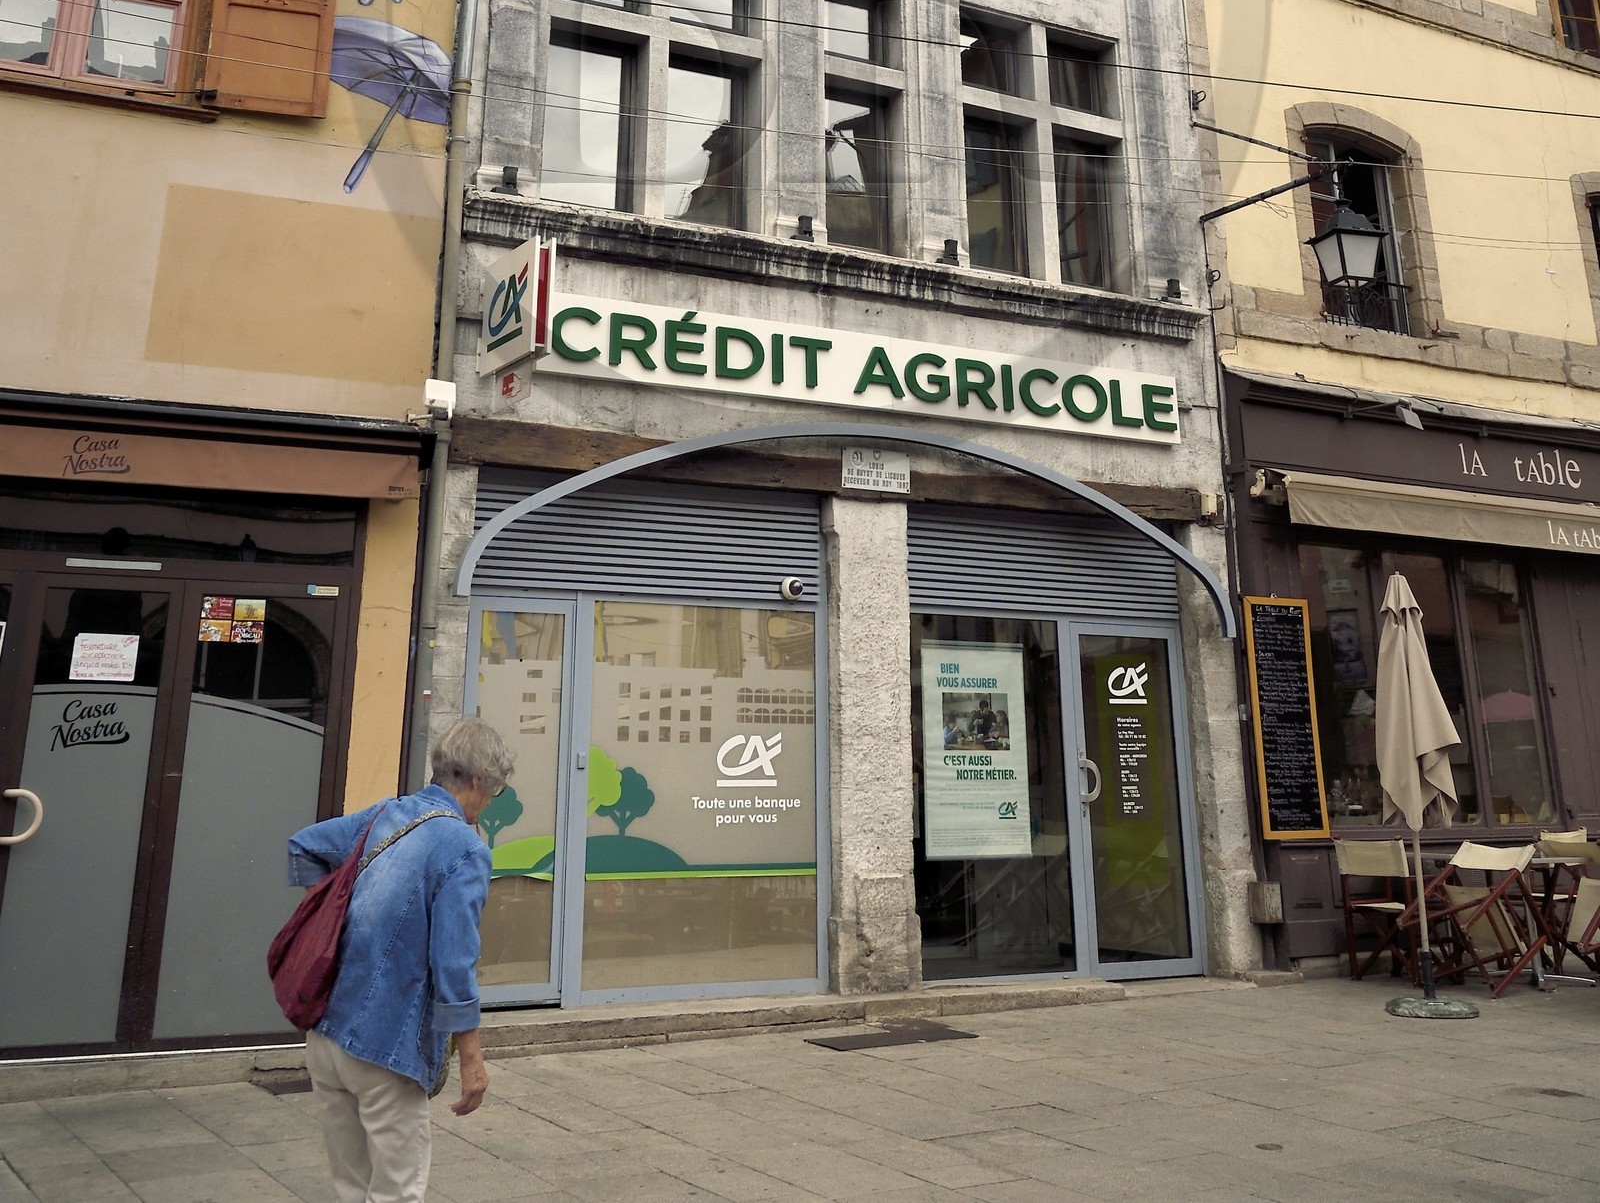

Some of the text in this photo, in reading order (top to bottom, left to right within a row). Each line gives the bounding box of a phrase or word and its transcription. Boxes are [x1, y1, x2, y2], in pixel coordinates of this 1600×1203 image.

[551, 306, 1178, 432] CRÉDIT AGRICOLE
[73, 435, 120, 454] Casa
[62, 453, 131, 477] Nostra
[844, 476, 870, 486] RECEVEUR
[847, 468, 854, 476] DE
[875, 471, 883, 479] DE
[940, 663, 960, 674] BIEN
[936, 677, 998, 689] VOUS ASSURER
[63, 699, 118, 724] Casa
[50, 716, 130, 751] Nostra
[944, 755, 992, 766] C'EST AUSSI
[956, 767, 1017, 780] NOTRE MÉTIER.
[691, 796, 801, 811] Toute une banque
[715, 813, 778, 828] pour vous
